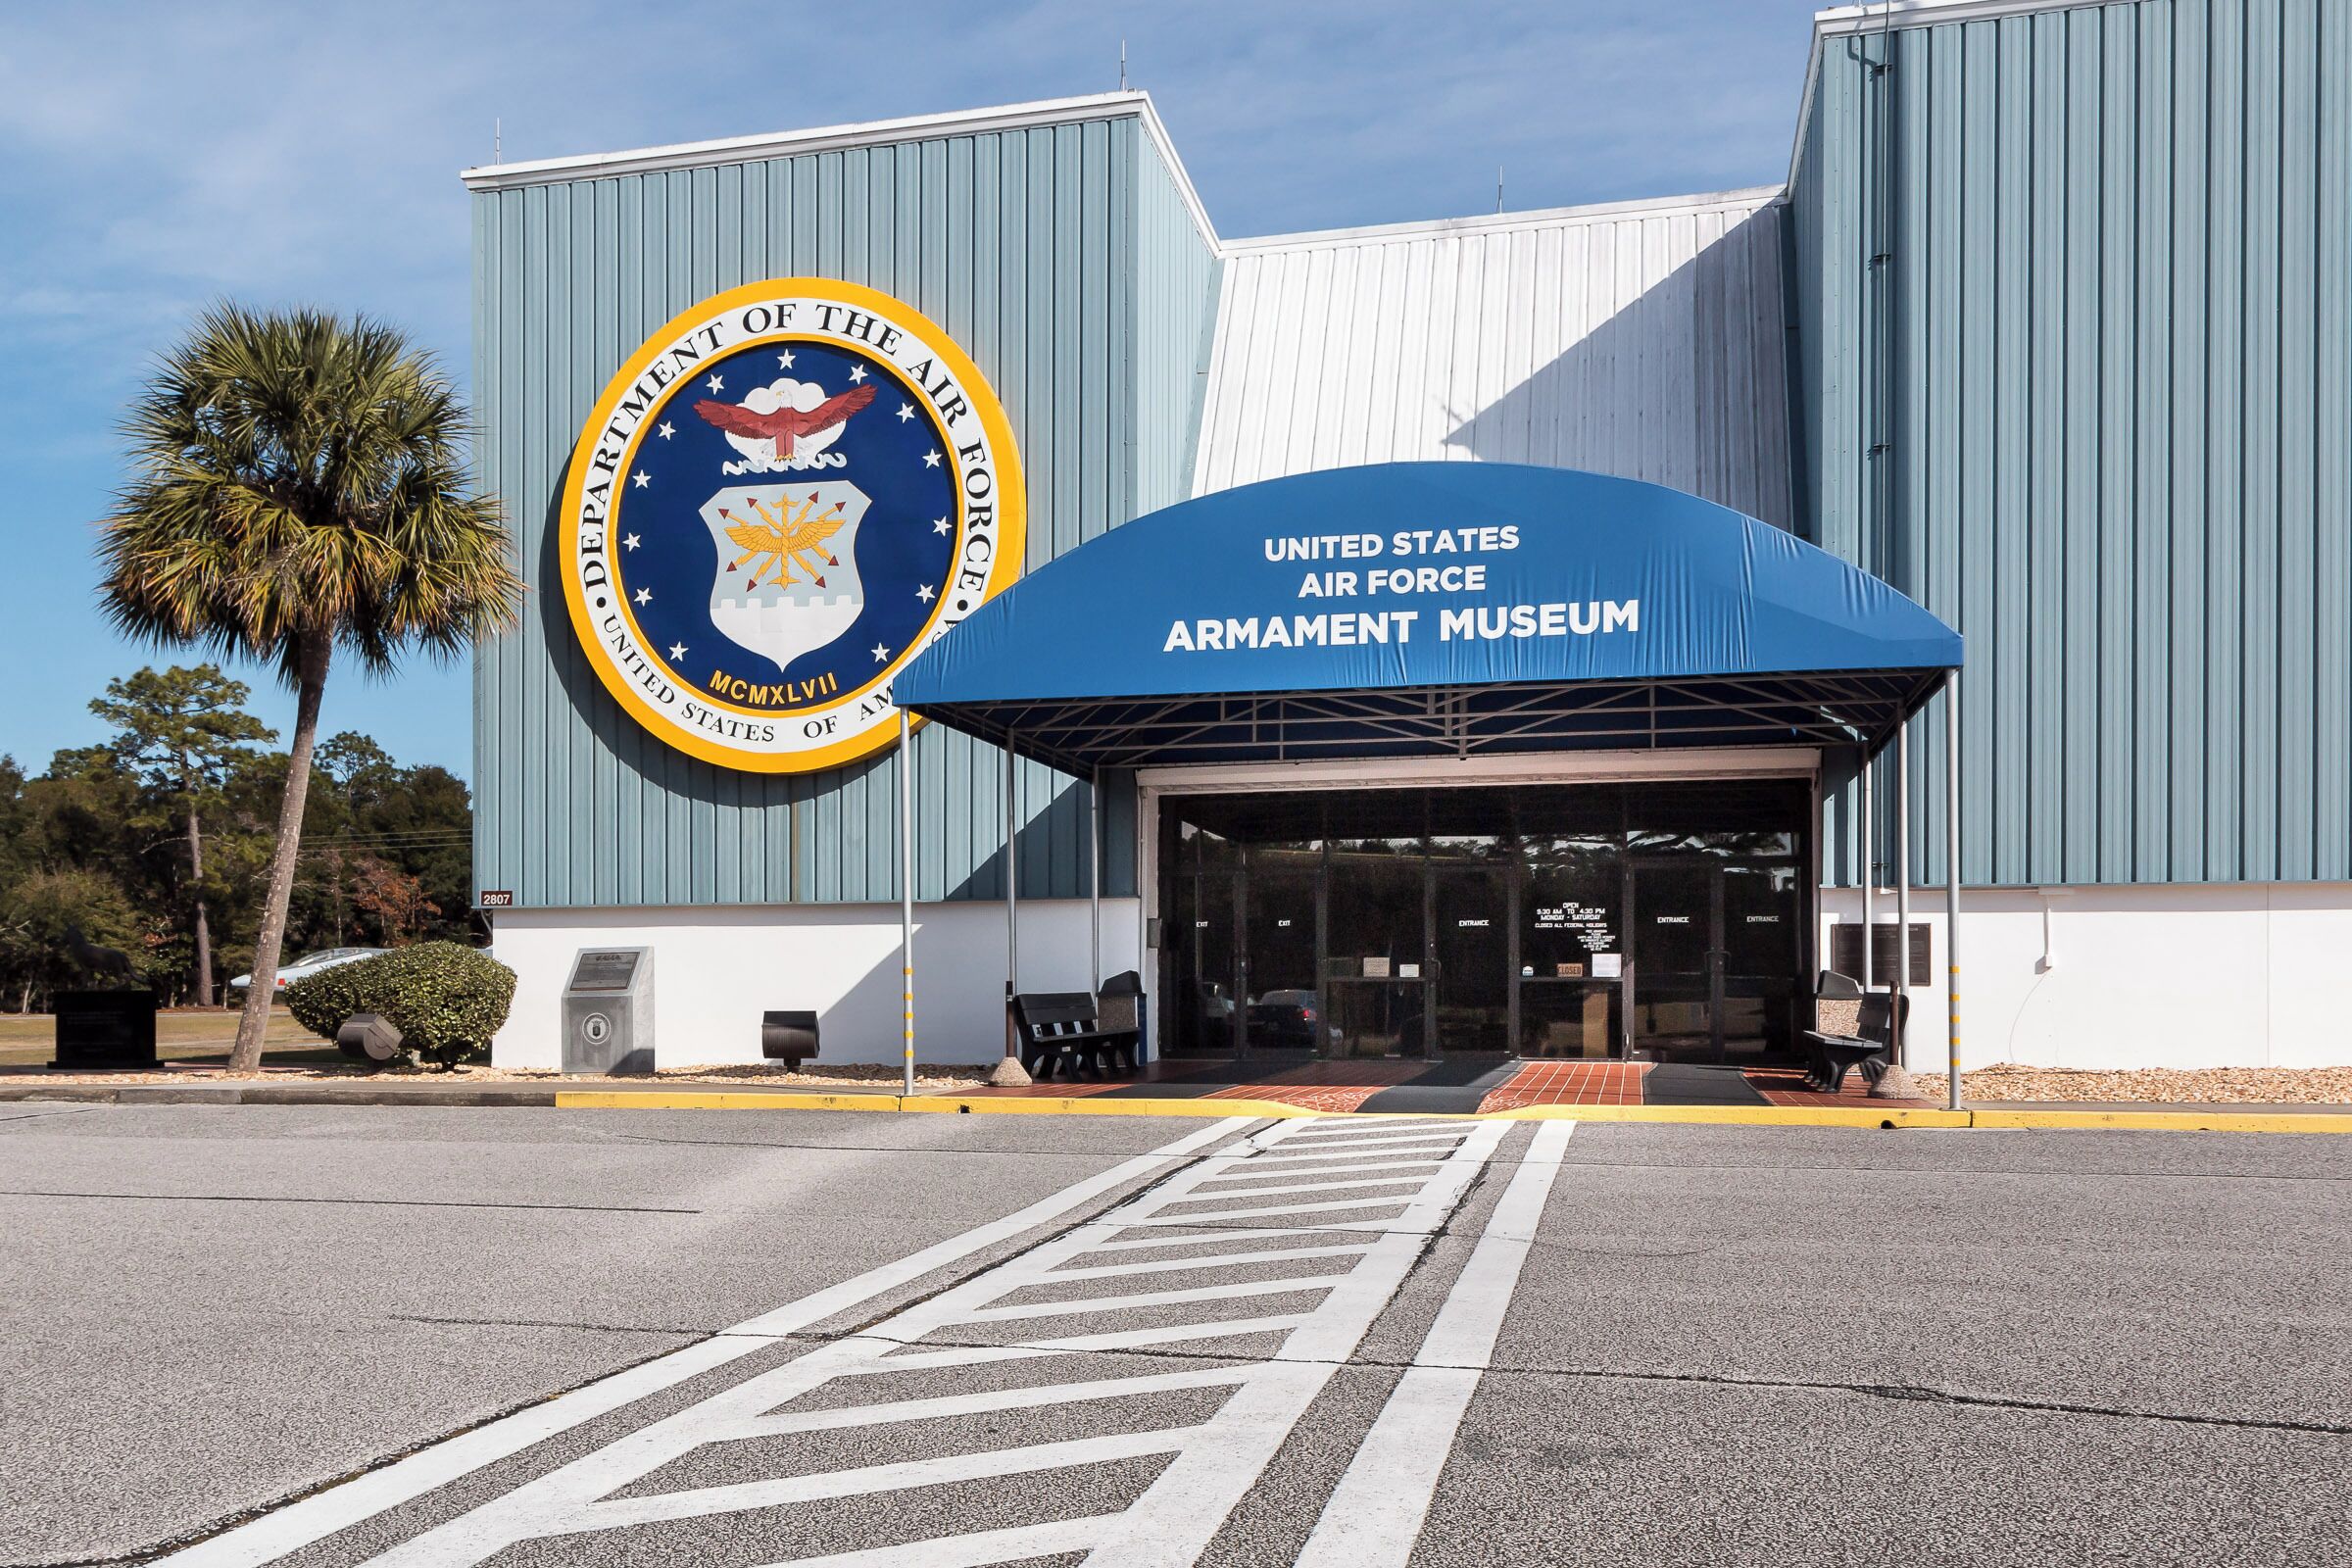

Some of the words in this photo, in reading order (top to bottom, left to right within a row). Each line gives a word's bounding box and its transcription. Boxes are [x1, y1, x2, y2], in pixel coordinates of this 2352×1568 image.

[581, 320, 724, 592] DEPARTMENT
[742, 302, 797, 334] OF
[815, 304, 903, 357] THE
[906, 358, 967, 429] AIR
[957, 437, 993, 593] FORCE
[1264, 533, 1384, 563] UNITED
[1392, 524, 1520, 556] STATES
[1298, 571, 1358, 598] AIR
[1367, 564, 1487, 595] FORCE
[1162, 611, 1419, 653] ARMAMENT
[1440, 599, 1640, 642] MUSEUM
[603, 612, 676, 705] UNITED
[680, 697, 775, 743] STATES
[803, 715, 839, 740] OF
[709, 669, 838, 706] MCMXLVII
[483, 894, 511, 906] 2807
[1557, 965, 1582, 975] CLOSED
